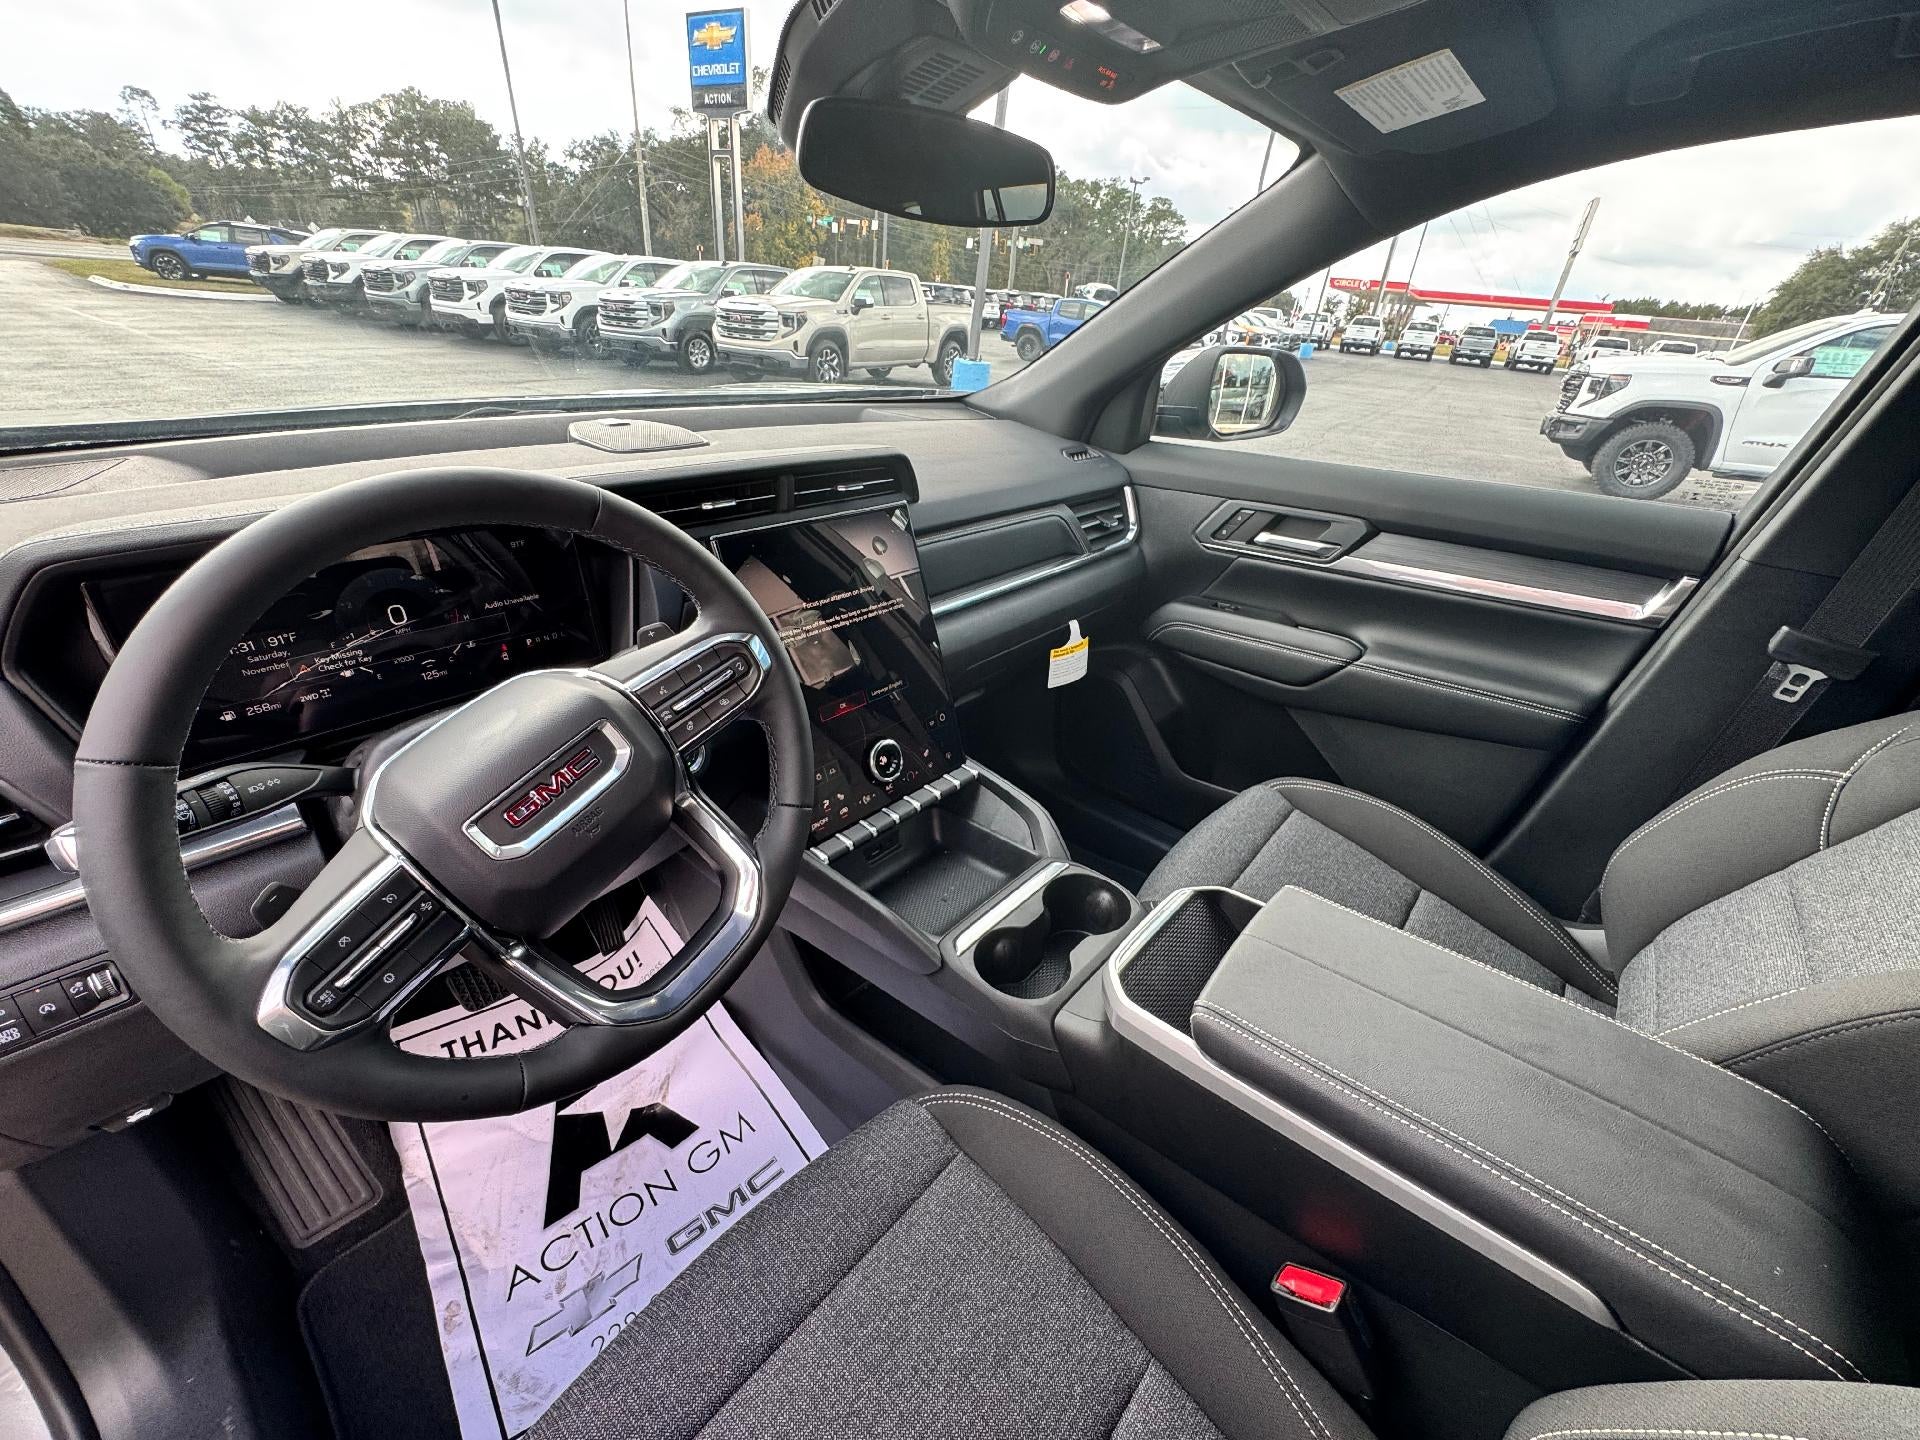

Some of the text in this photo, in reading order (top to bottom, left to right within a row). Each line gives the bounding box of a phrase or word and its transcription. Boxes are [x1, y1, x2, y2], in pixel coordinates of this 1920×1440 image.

[692, 62, 741, 77] CHEVROLET
[704, 93, 732, 105] ACTION
[1333, 279, 1370, 290] CIRCLE K
[387, 604, 408, 626] 0
[267, 632, 297, 647] 91°F
[314, 650, 363, 665] Key Missing
[241, 661, 290, 676] November
[318, 660, 345, 672] Check
[344, 659, 356, 667] for
[299, 692, 319, 703] 2WD
[504, 747, 601, 827] GMC
[440, 950, 643, 1058] THAN OU!
[506, 1111, 757, 1303] ACTION GM
[664, 1156, 785, 1257] GMC
